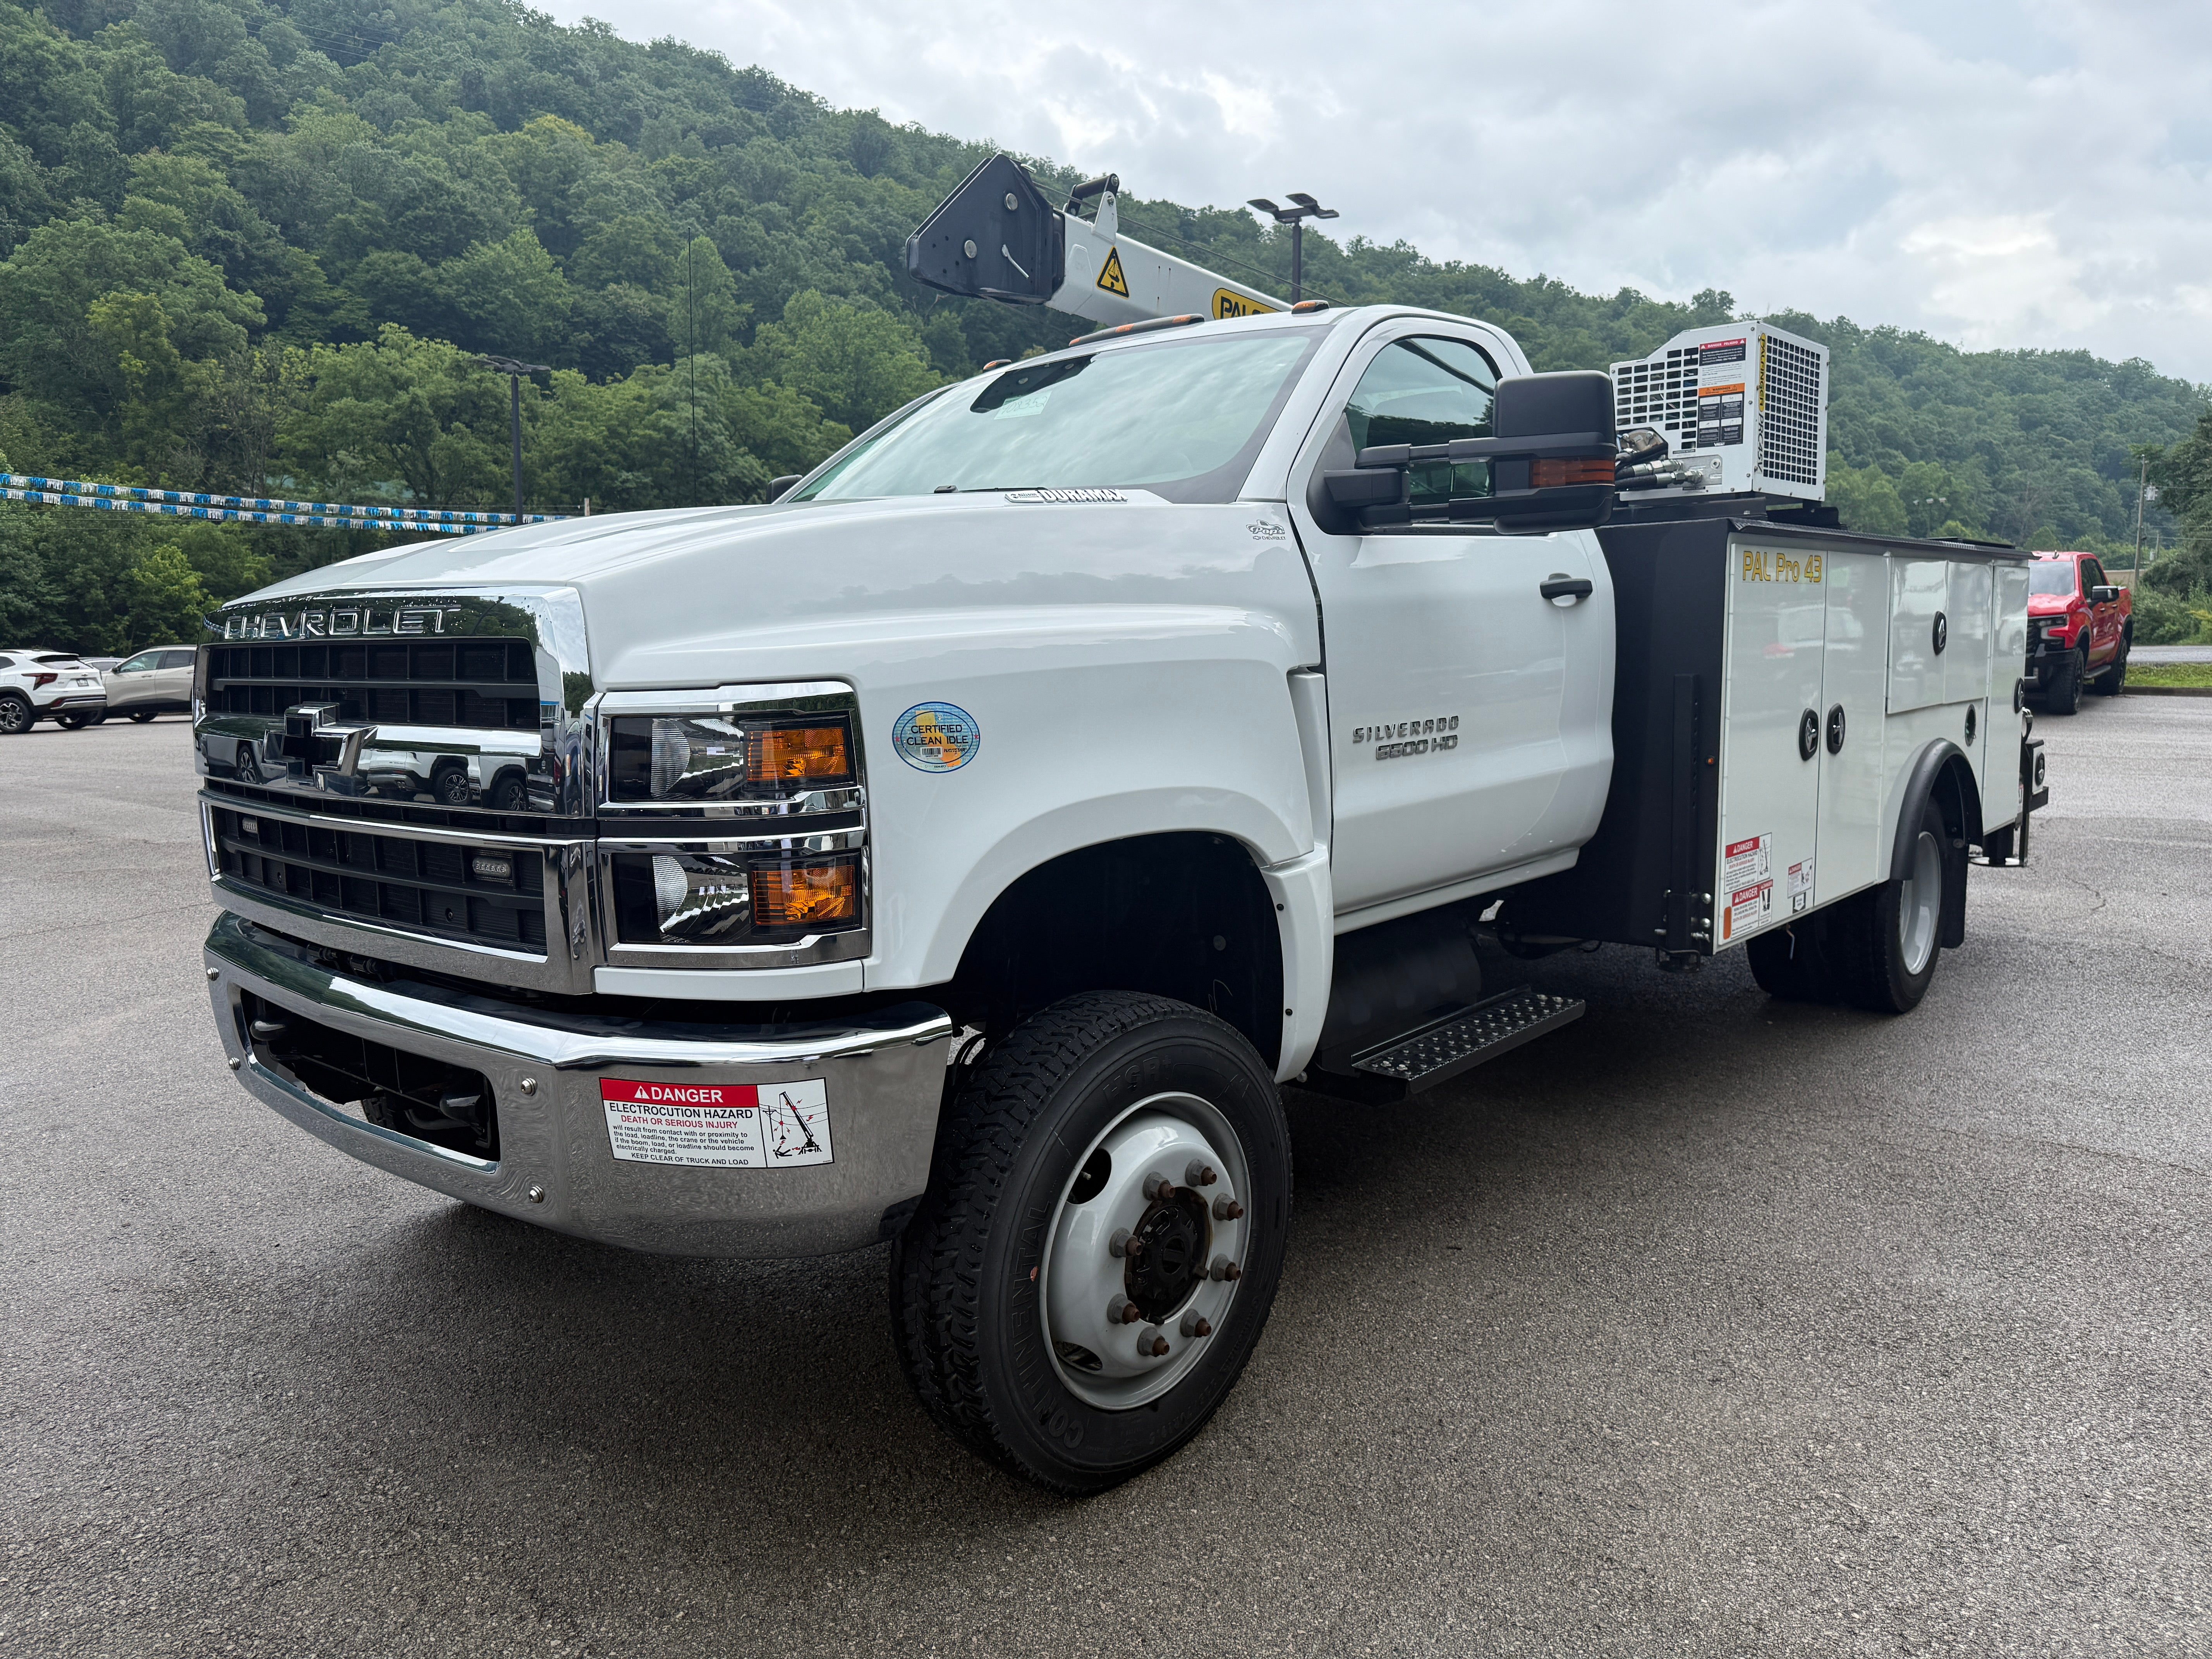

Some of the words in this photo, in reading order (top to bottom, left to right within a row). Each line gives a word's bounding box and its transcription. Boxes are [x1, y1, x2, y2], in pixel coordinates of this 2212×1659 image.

[1039, 489, 1128, 502] DURAMAX
[1249, 526, 1285, 535] Pop's
[1743, 551, 1771, 581] PAL
[1776, 553, 1800, 582] Pro
[1804, 555, 1822, 583] 43
[225, 605, 461, 639] CHEVROLET
[911, 725, 962, 733] CERTIFIED
[1353, 715, 1459, 743] SILVERADO
[907, 737, 942, 745] CLEAN
[947, 735, 969, 744] IDLE
[1431, 734, 1458, 752] HD
[1737, 841, 1753, 853] DANGER
[1739, 887, 1758, 902] DANGER
[651, 1087, 724, 1103] DANGER
[610, 1103, 701, 1118] ELECTROCUTION
[704, 1109, 752, 1119] HAZARD
[621, 1115, 648, 1124] DEATH
[665, 1119, 703, 1128] SERIOUS
[617, 1144, 648, 1152] electrically
[1012, 1200, 1084, 1449] CONTINENTAL
